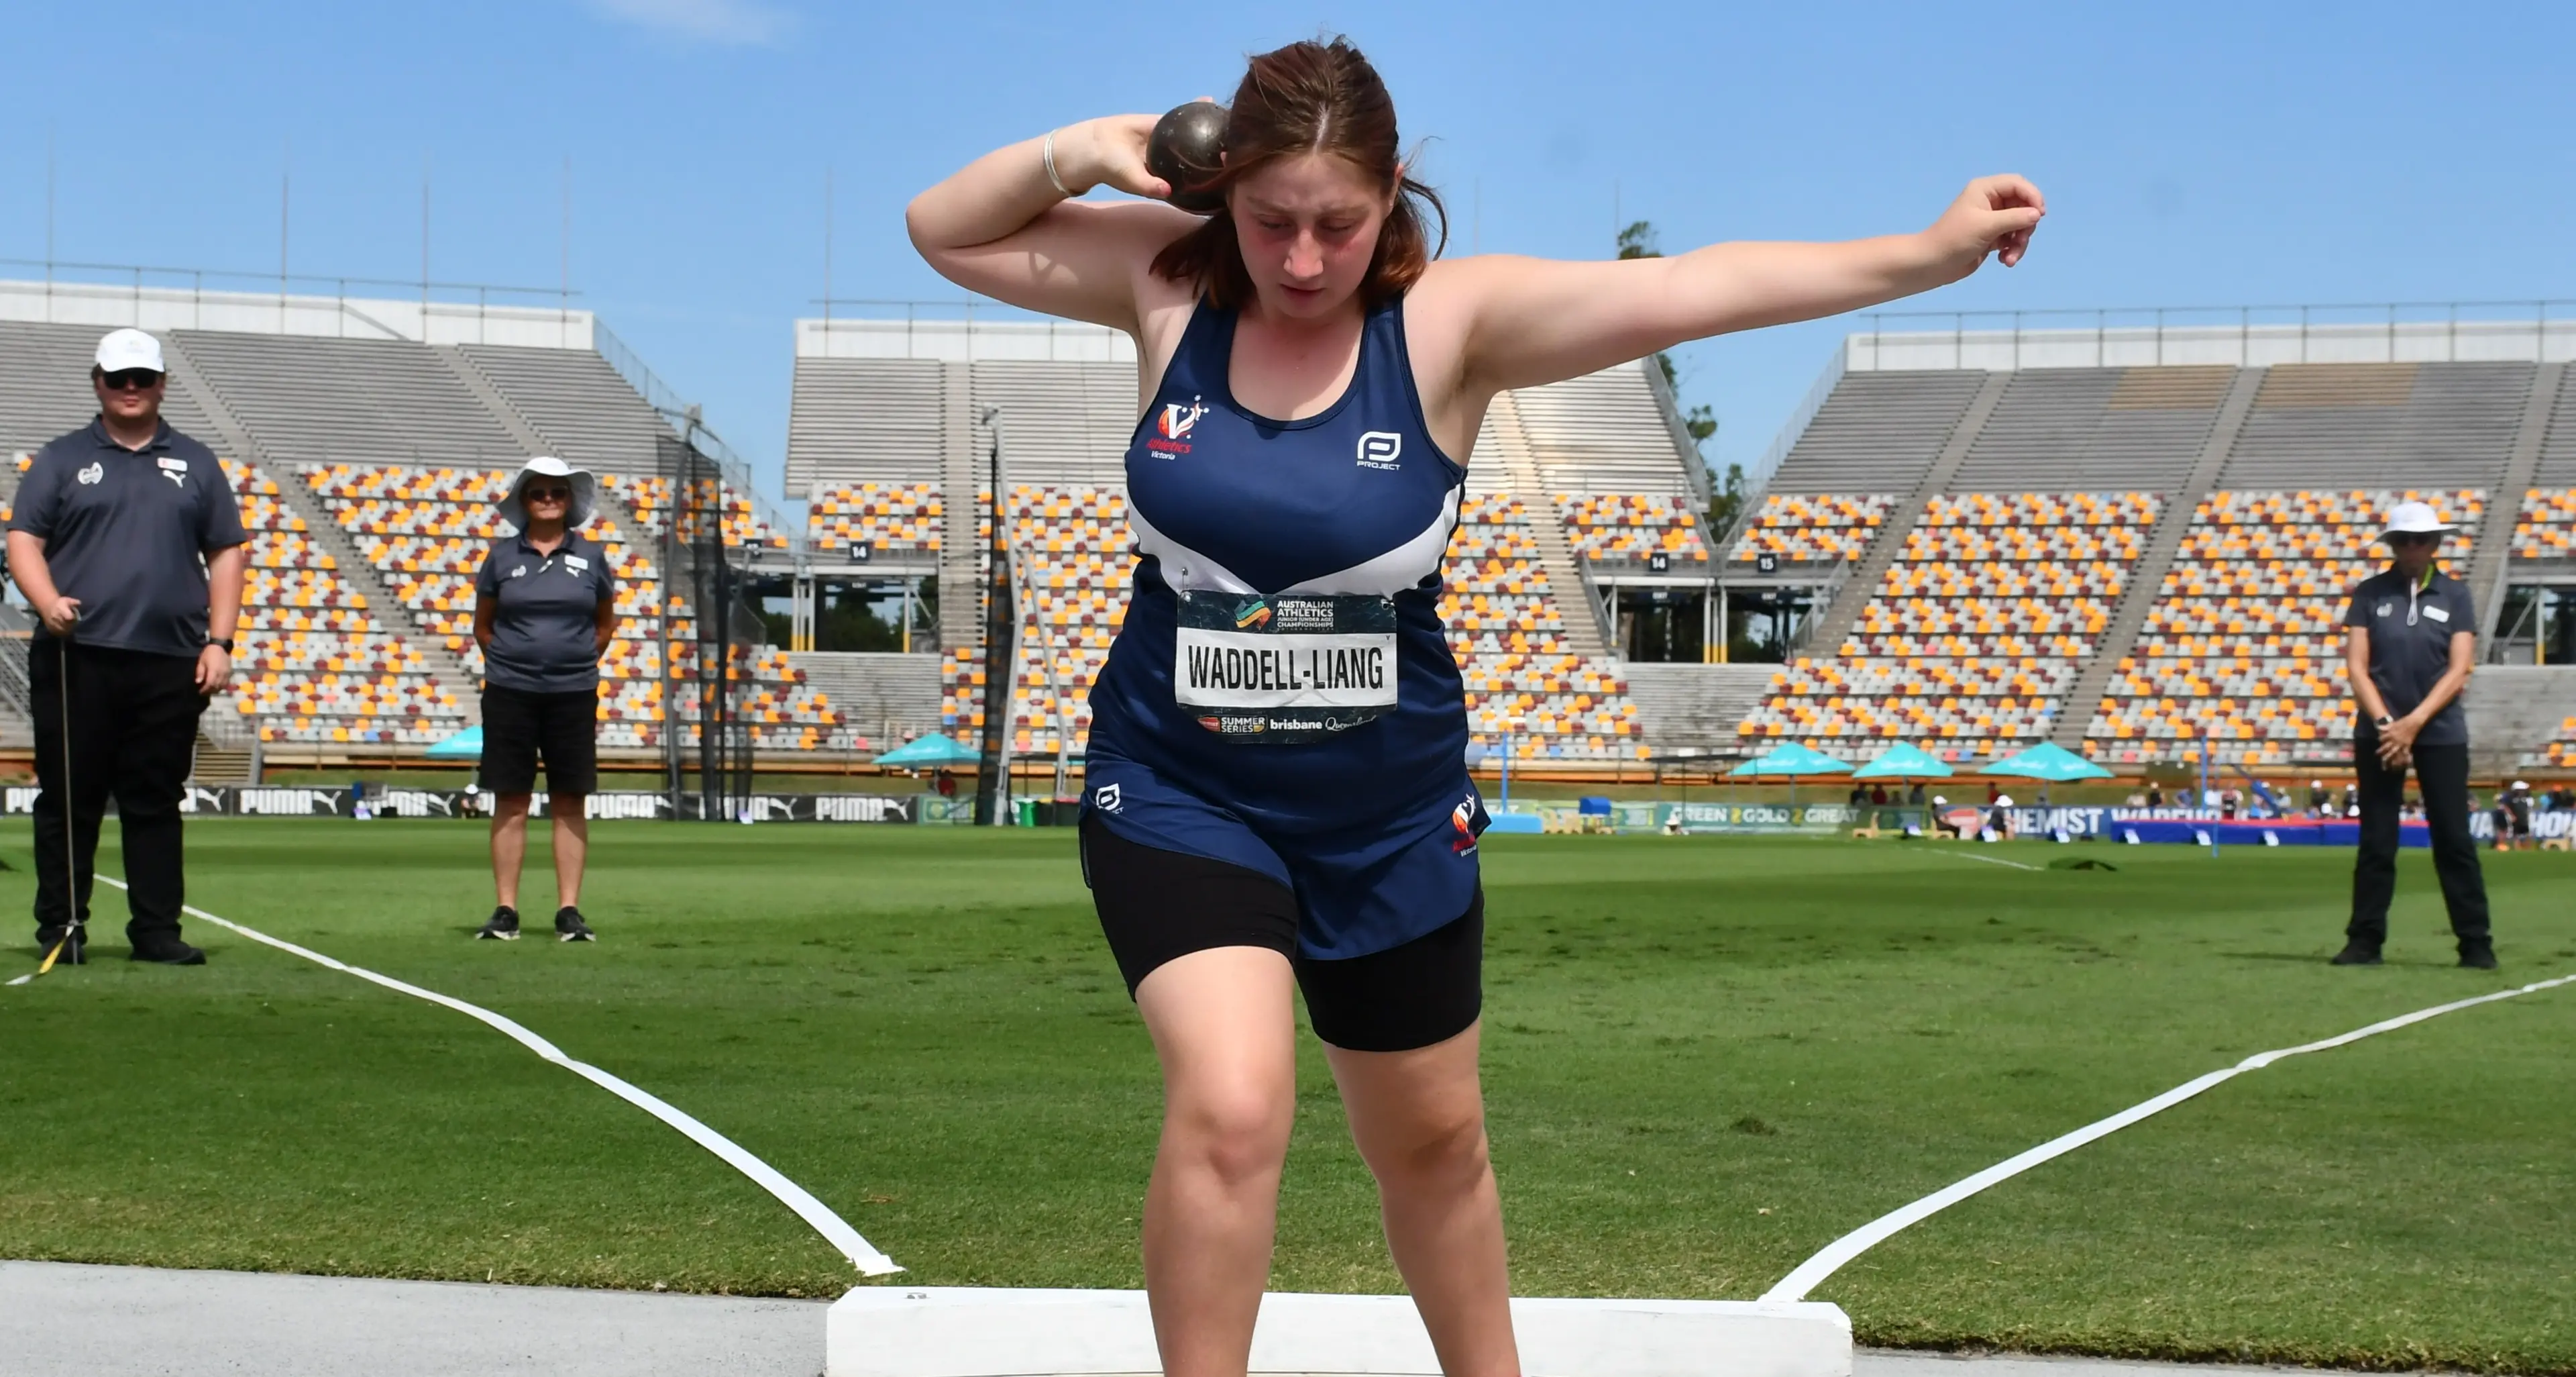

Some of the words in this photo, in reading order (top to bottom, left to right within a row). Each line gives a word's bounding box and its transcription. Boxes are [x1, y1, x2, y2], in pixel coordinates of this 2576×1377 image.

[1146, 438, 1191, 454] Athletics
[1151, 450, 1175, 460] Victoria
[1356, 460, 1401, 471] PROJECT
[853, 546, 867, 558] 14
[1652, 557, 1666, 569] 14
[1760, 558, 1774, 570] 15
[1277, 600, 1334, 608] AUSTRALIAN
[1277, 609, 1334, 617] ATHLETICS
[1187, 645, 1383, 691] WADDELL-LIANG
[1221, 717, 1265, 725] SUMMER
[1270, 719, 1322, 729] brisbane
[1221, 725, 1253, 733] SERIES
[240, 789, 313, 814] PUMA
[584, 795, 655, 819] PUMA
[816, 797, 884, 821] PUMA
[1670, 807, 1727, 823] GREEN
[1742, 808, 1790, 823] GOLD
[1805, 808, 1860, 823] GREAT
